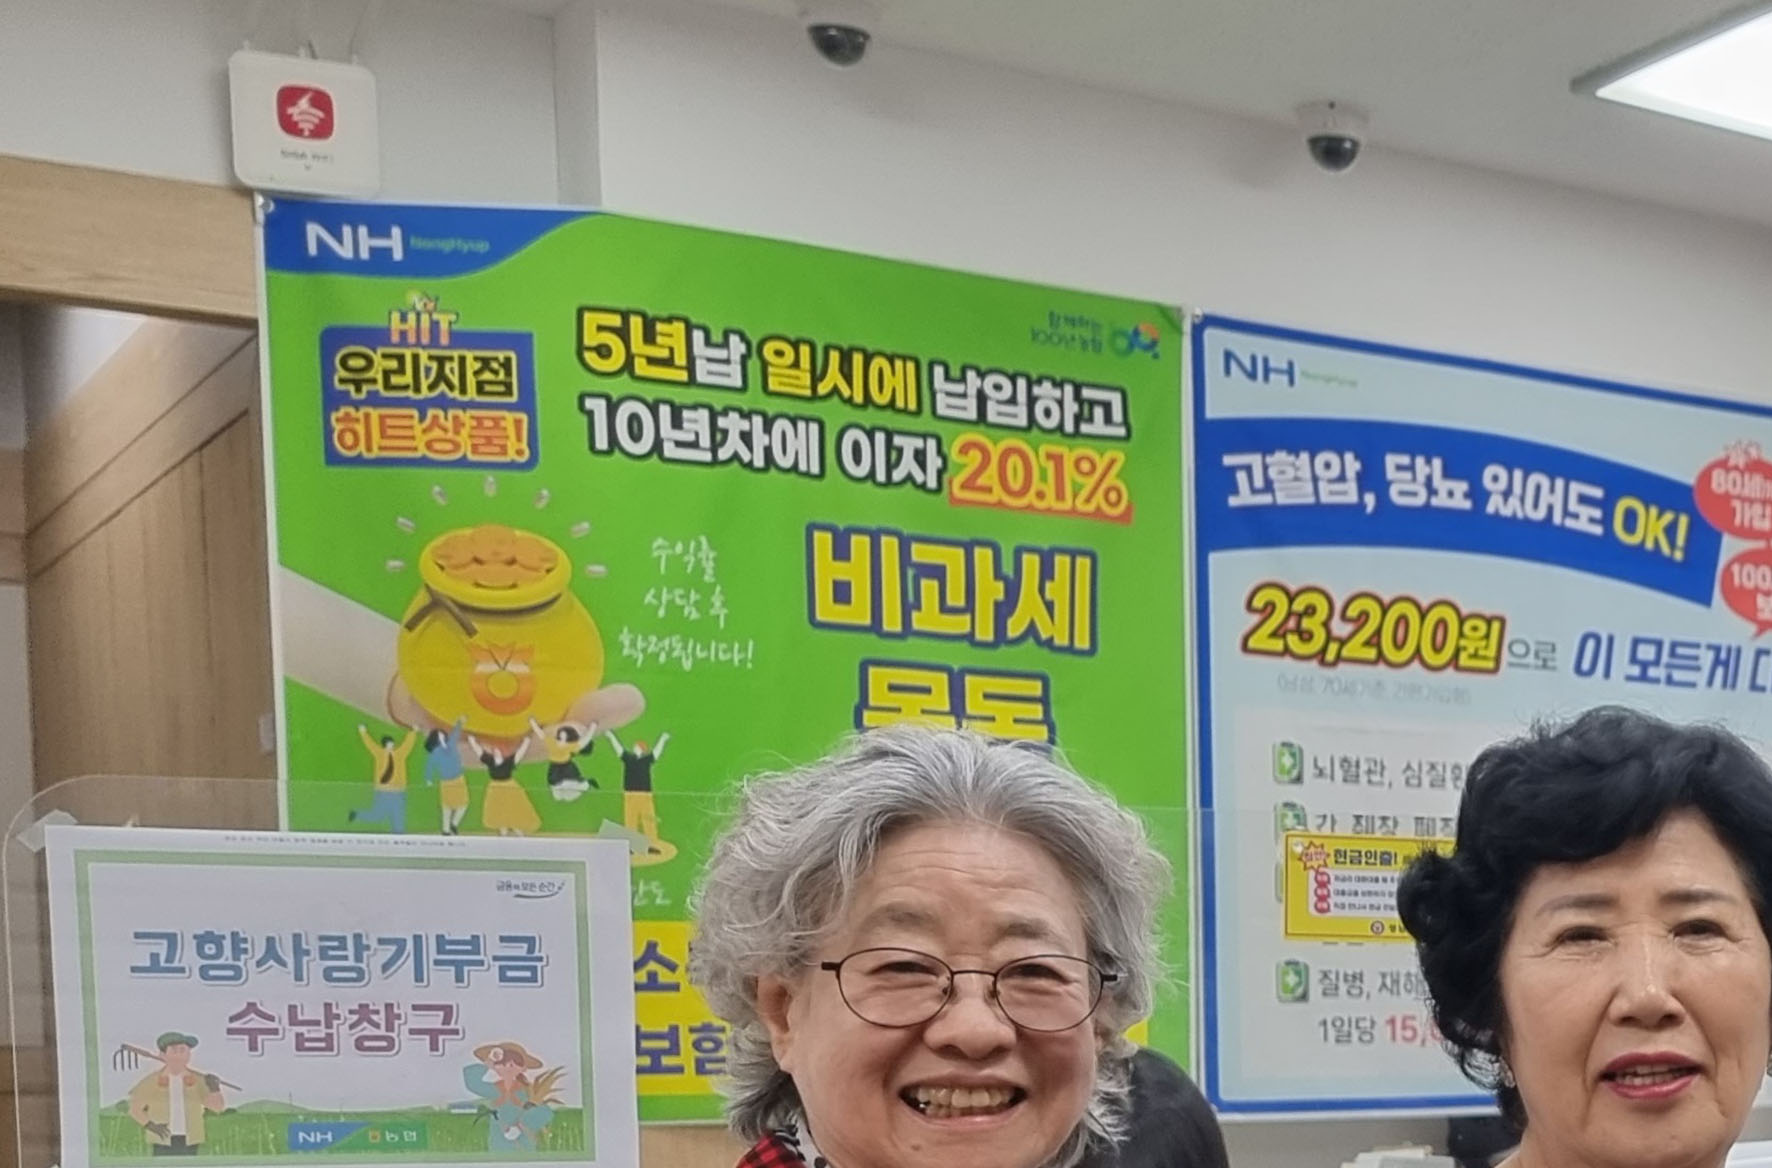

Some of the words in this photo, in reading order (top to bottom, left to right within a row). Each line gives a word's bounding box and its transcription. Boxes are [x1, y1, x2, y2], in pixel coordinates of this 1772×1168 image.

[306, 220, 403, 260] NH
[389, 308, 458, 346] HIT
[334, 346, 517, 402] 우리지점
[578, 307, 747, 389] 5년납
[760, 334, 920, 414] 일시에
[930, 361, 1131, 440] 납입하고
[1223, 348, 1296, 388] NH
[333, 409, 531, 460] 히트상품!
[581, 396, 824, 476] 10년차에
[839, 425, 946, 493] 이자
[950, 433, 1132, 520] 20.1%
[1221, 450, 1377, 514] 고혈압,
[1384, 452, 1474, 510] 당뇨
[1481, 463, 1605, 536] 있어도
[1612, 495, 1691, 562] OK!
[643, 585, 702, 624] 상담
[707, 587, 730, 627] 후
[806, 521, 1097, 656] 비과세
[617, 624, 757, 671] 확정됩니다!
[1242, 581, 1506, 680] 23,200원
[1507, 639, 1559, 671] 으로
[1573, 630, 1614, 680] 이
[1624, 635, 1741, 692] 모든게
[1312, 755, 1393, 789] 뇌혈관,
[129, 927, 547, 989] 고향사랑기부금
[1318, 969, 1371, 1000] 질병,
[225, 999, 466, 1059] 수납창구
[1318, 1015, 1377, 1044] 1일당
[298, 1129, 333, 1145] NH
